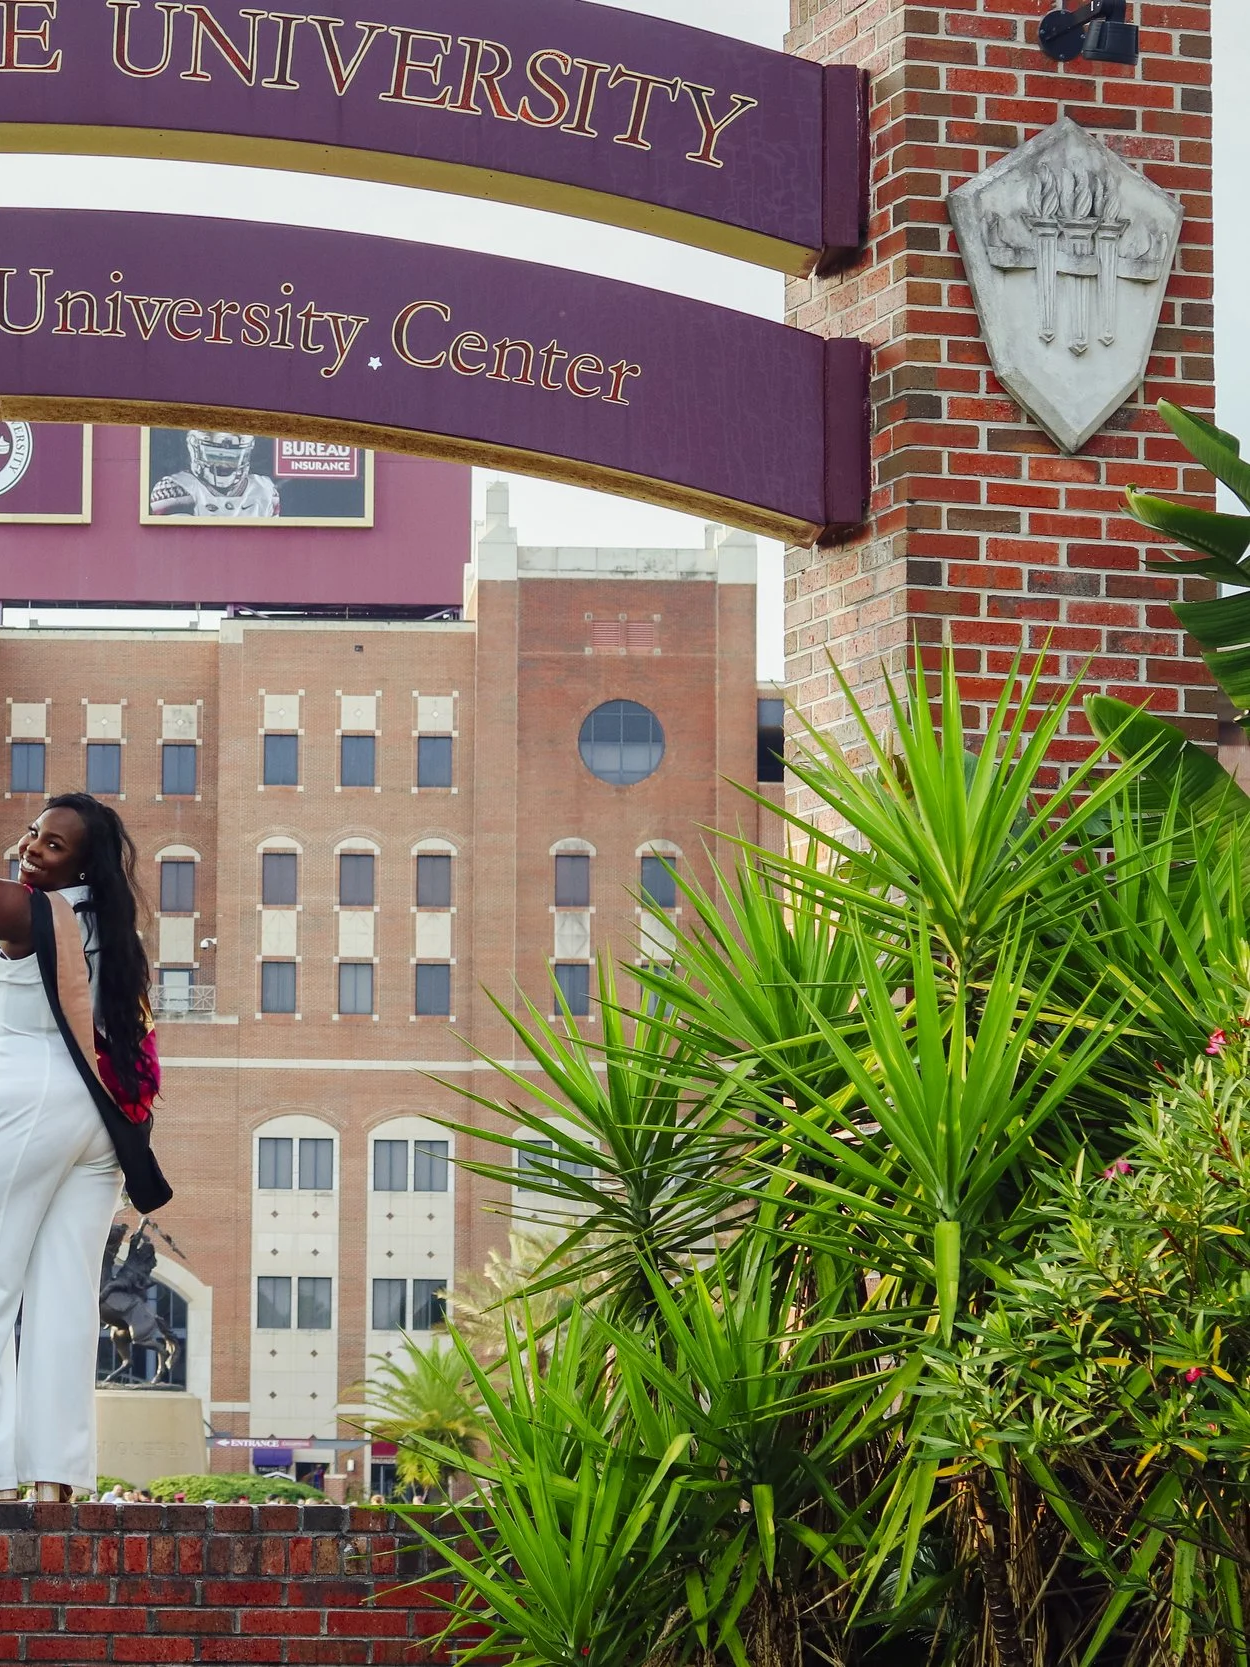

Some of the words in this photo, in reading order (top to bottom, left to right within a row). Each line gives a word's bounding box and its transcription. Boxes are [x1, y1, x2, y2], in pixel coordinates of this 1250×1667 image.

[106, 0, 757, 169] UNIVERSITY
[391, 300, 642, 406] Center
[282, 441, 351, 457] BUREAU
[291, 461, 351, 472] INSURANCE
[230, 1439, 279, 1448] ENTRANCE
